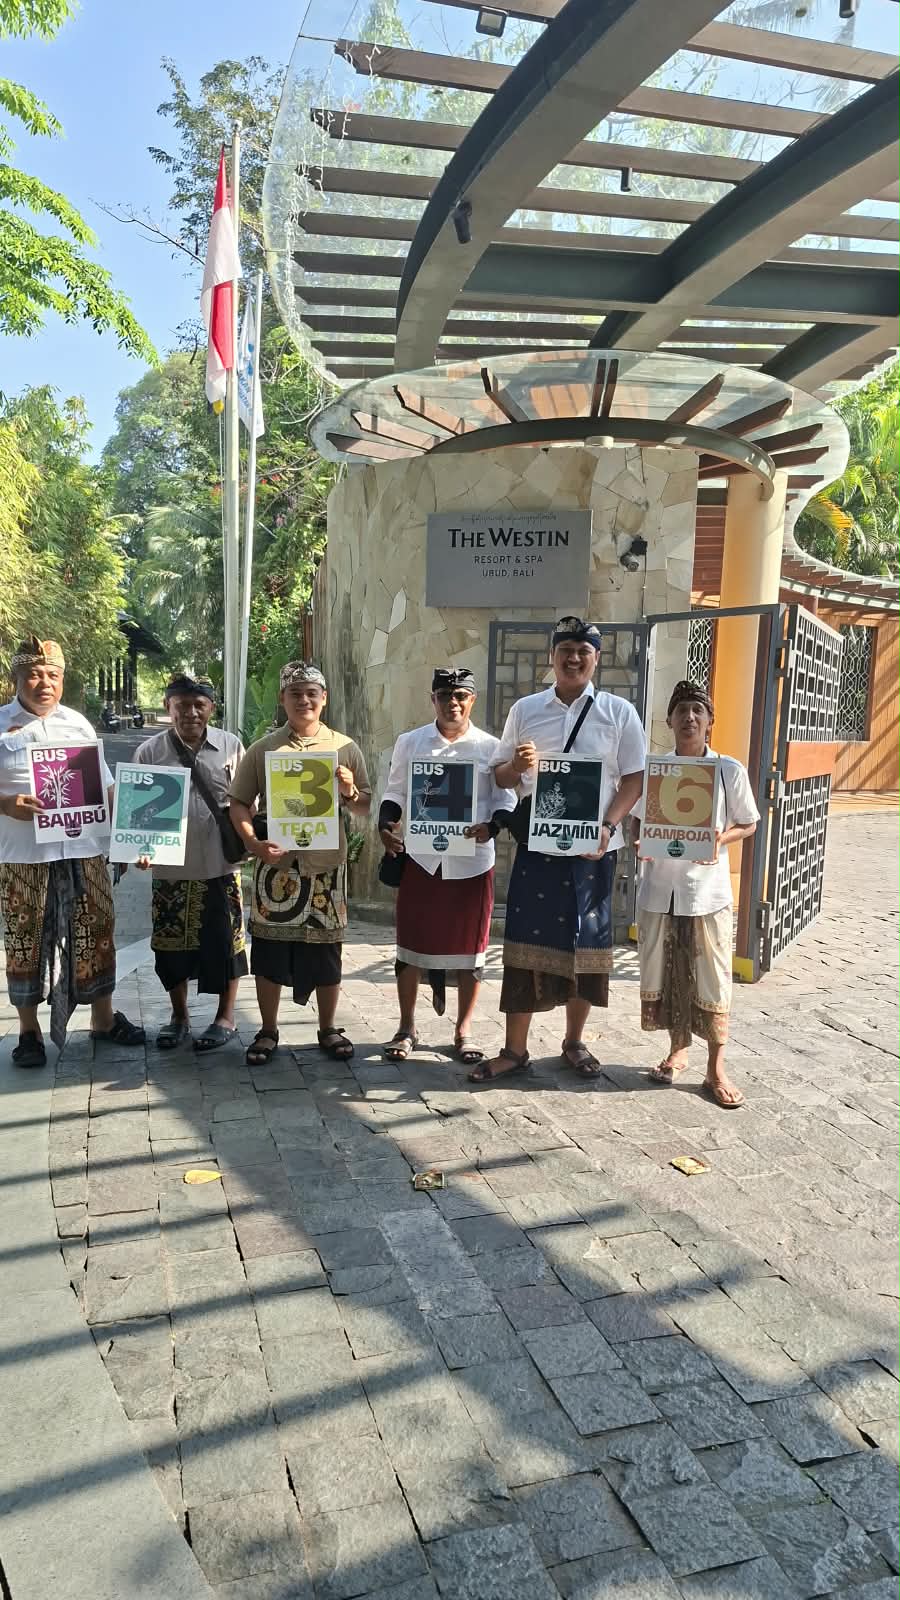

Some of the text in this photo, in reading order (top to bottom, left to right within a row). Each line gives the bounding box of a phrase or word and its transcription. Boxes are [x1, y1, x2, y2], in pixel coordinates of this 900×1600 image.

[448, 527, 569, 548] THE WESTIN
[474, 555, 543, 564] RESORT & SPA
[482, 569, 534, 578] UBUD, BALI
[32, 749, 68, 763] BUS
[271, 759, 303, 772] BUS
[413, 763, 444, 776] BUS
[539, 760, 571, 774] BUS
[649, 763, 683, 777] BUS
[284, 759, 333, 817] 3
[659, 765, 712, 826] 6
[120, 771, 181, 831] BUS 2
[38, 806, 106, 829] BAMBÚ
[280, 822, 328, 837] TECA
[531, 822, 600, 840] JAZMÍN
[643, 828, 712, 843] KAMBOJA
[115, 832, 181, 847] ORQUÍDEA
